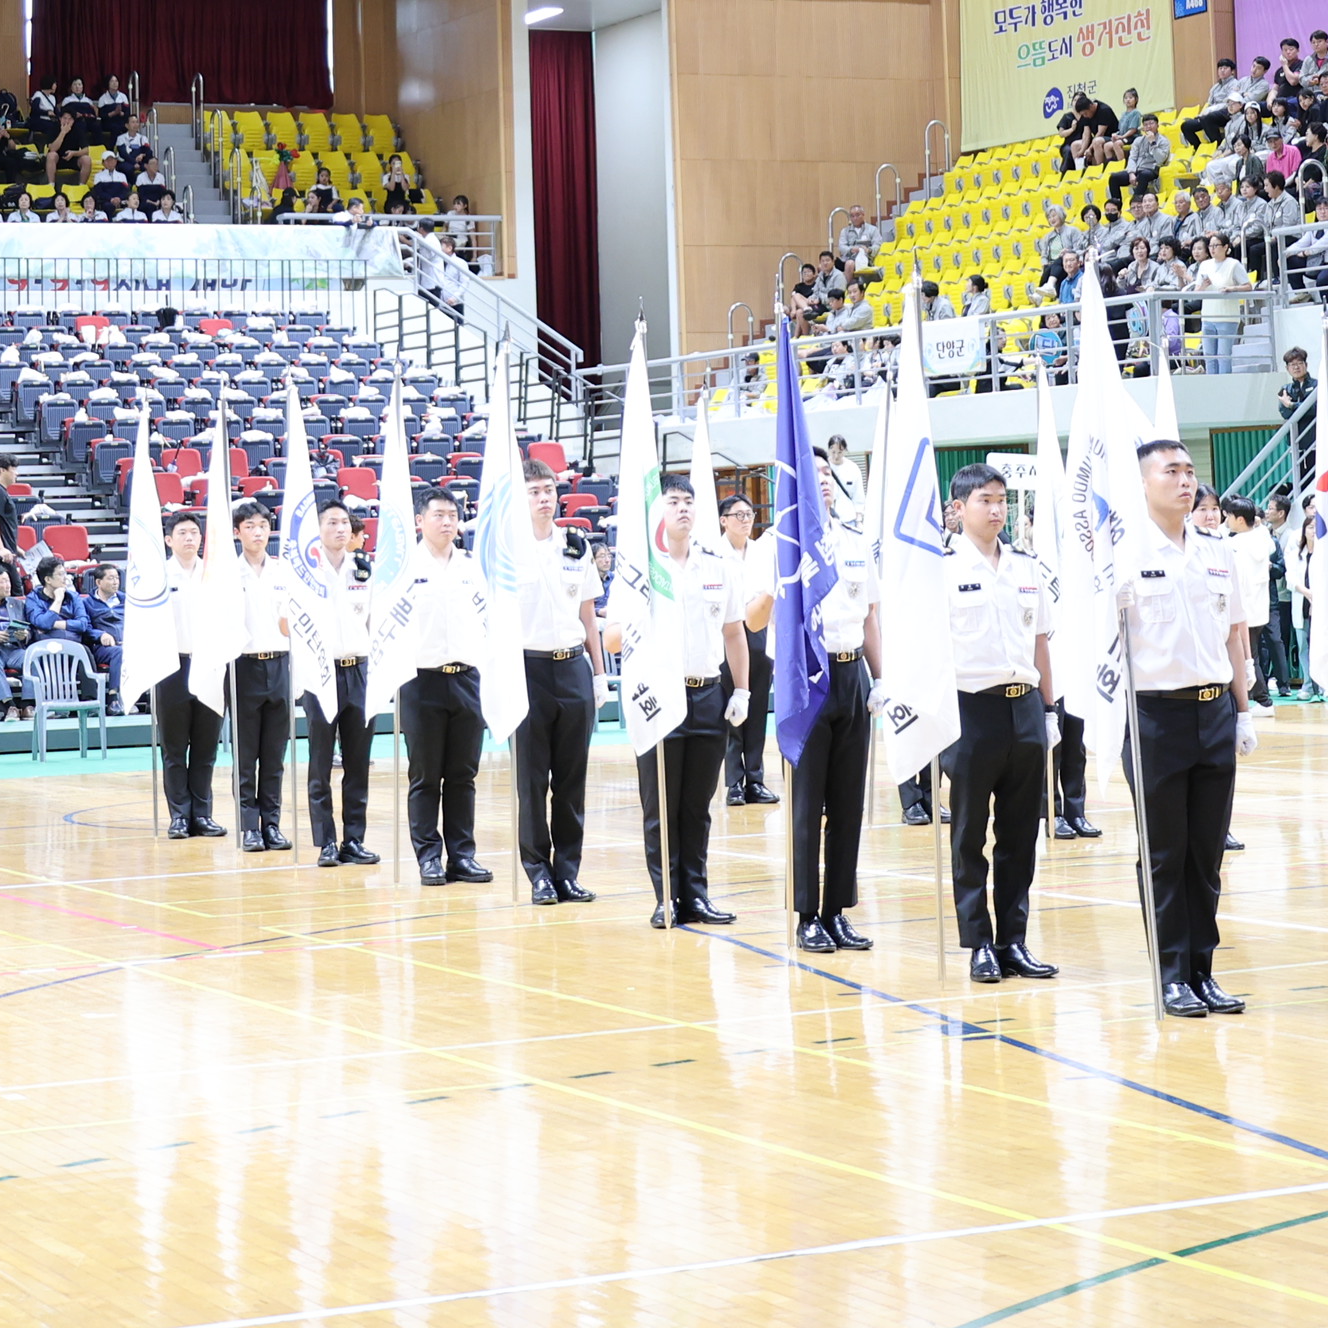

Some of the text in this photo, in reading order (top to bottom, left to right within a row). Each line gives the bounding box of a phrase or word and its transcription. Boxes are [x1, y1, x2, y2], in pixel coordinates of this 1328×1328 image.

[993, 3, 1037, 35] 모두가
[1017, 7, 1152, 69] 으뜸도시 생거진천
[936, 339, 965, 360] 단양군
